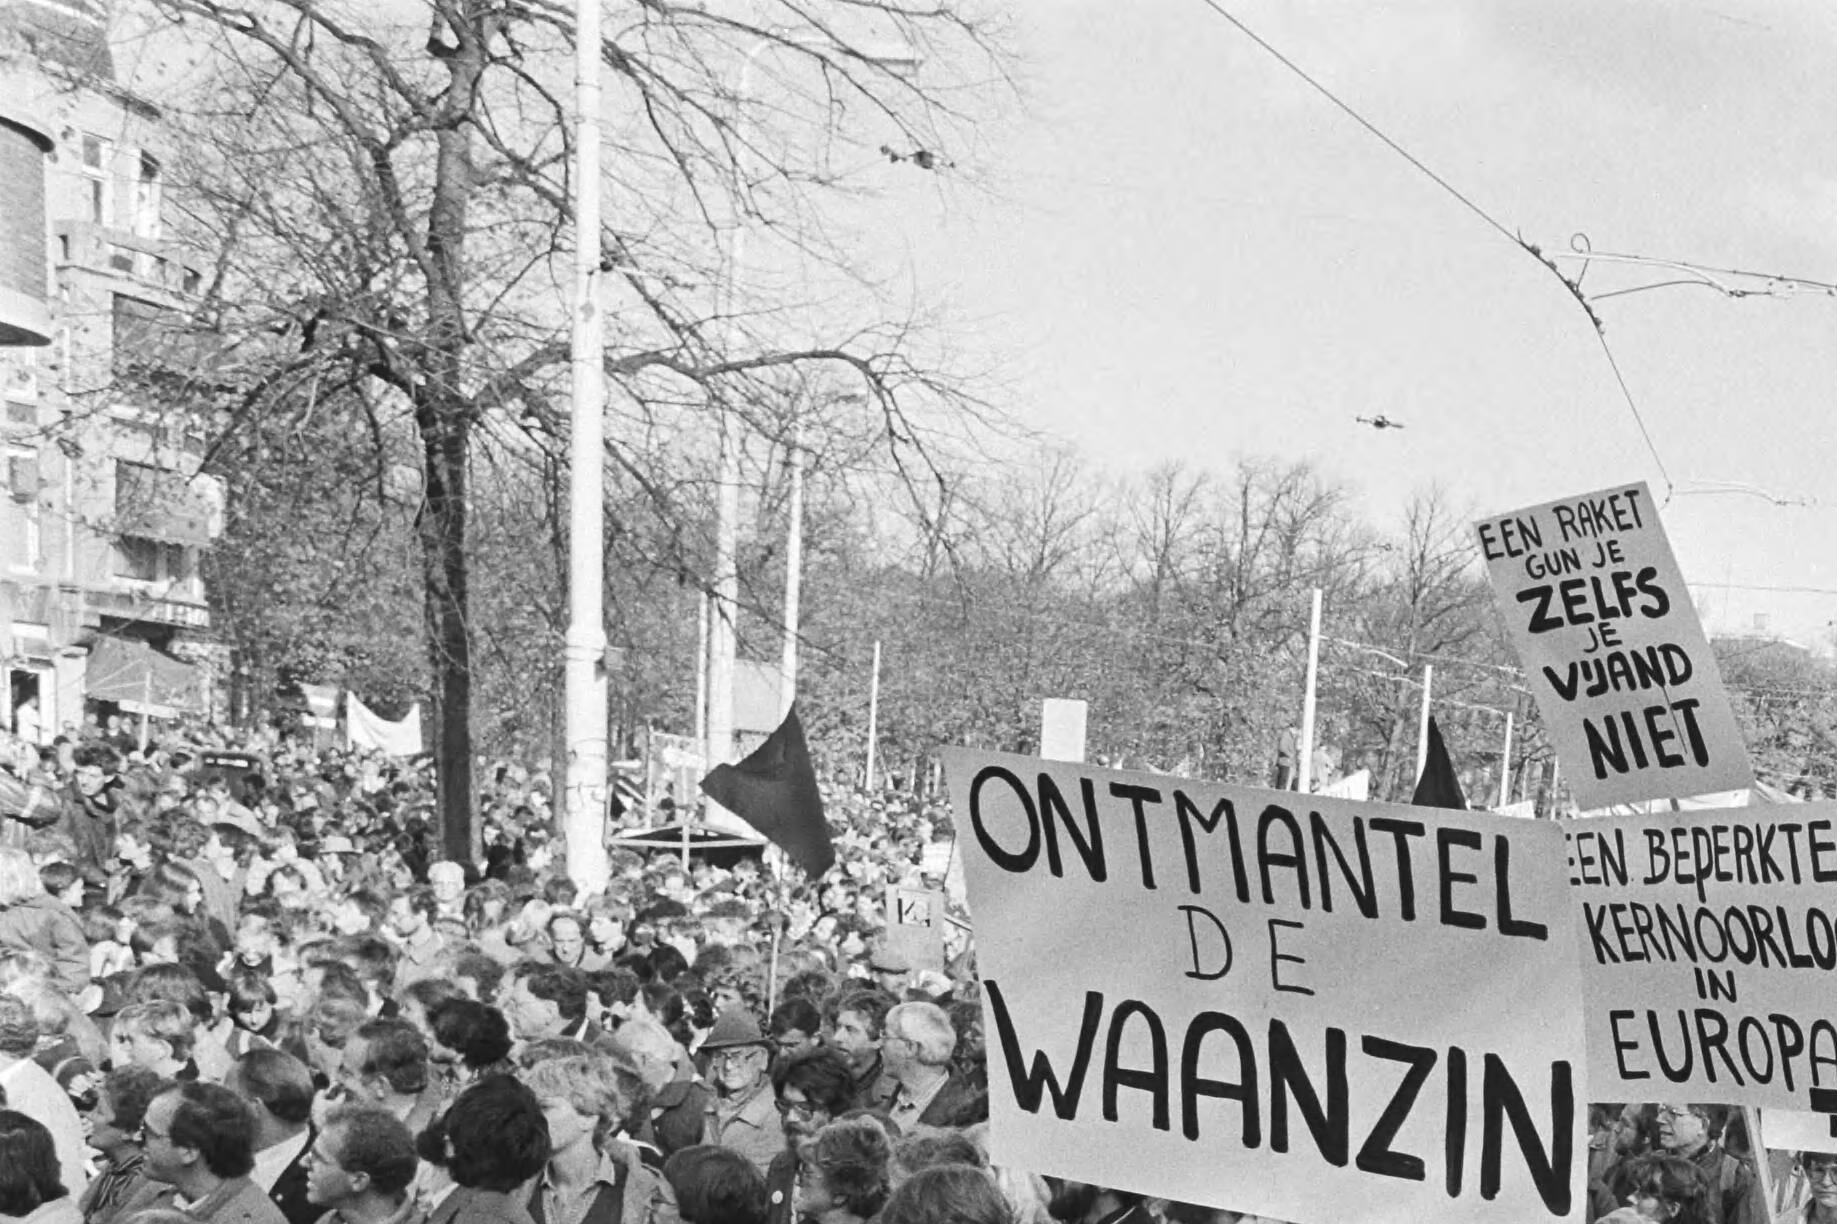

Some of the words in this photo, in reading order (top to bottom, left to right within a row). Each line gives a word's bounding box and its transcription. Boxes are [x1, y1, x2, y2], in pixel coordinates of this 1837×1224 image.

[1479, 515, 1543, 562] EEN
[1552, 489, 1643, 543] RAKET
[1525, 547, 1582, 580] GUN
[1592, 540, 1625, 569] JE
[1515, 566, 1670, 634] ZELFS
[1583, 621, 1623, 654] JE
[1583, 698, 1709, 780] NIET
[969, 765, 1548, 942] ONTMANTEL
[1177, 904, 1315, 997] DE
[1693, 966, 1738, 1004] IN
[983, 978, 1573, 1218] WAANZIN
